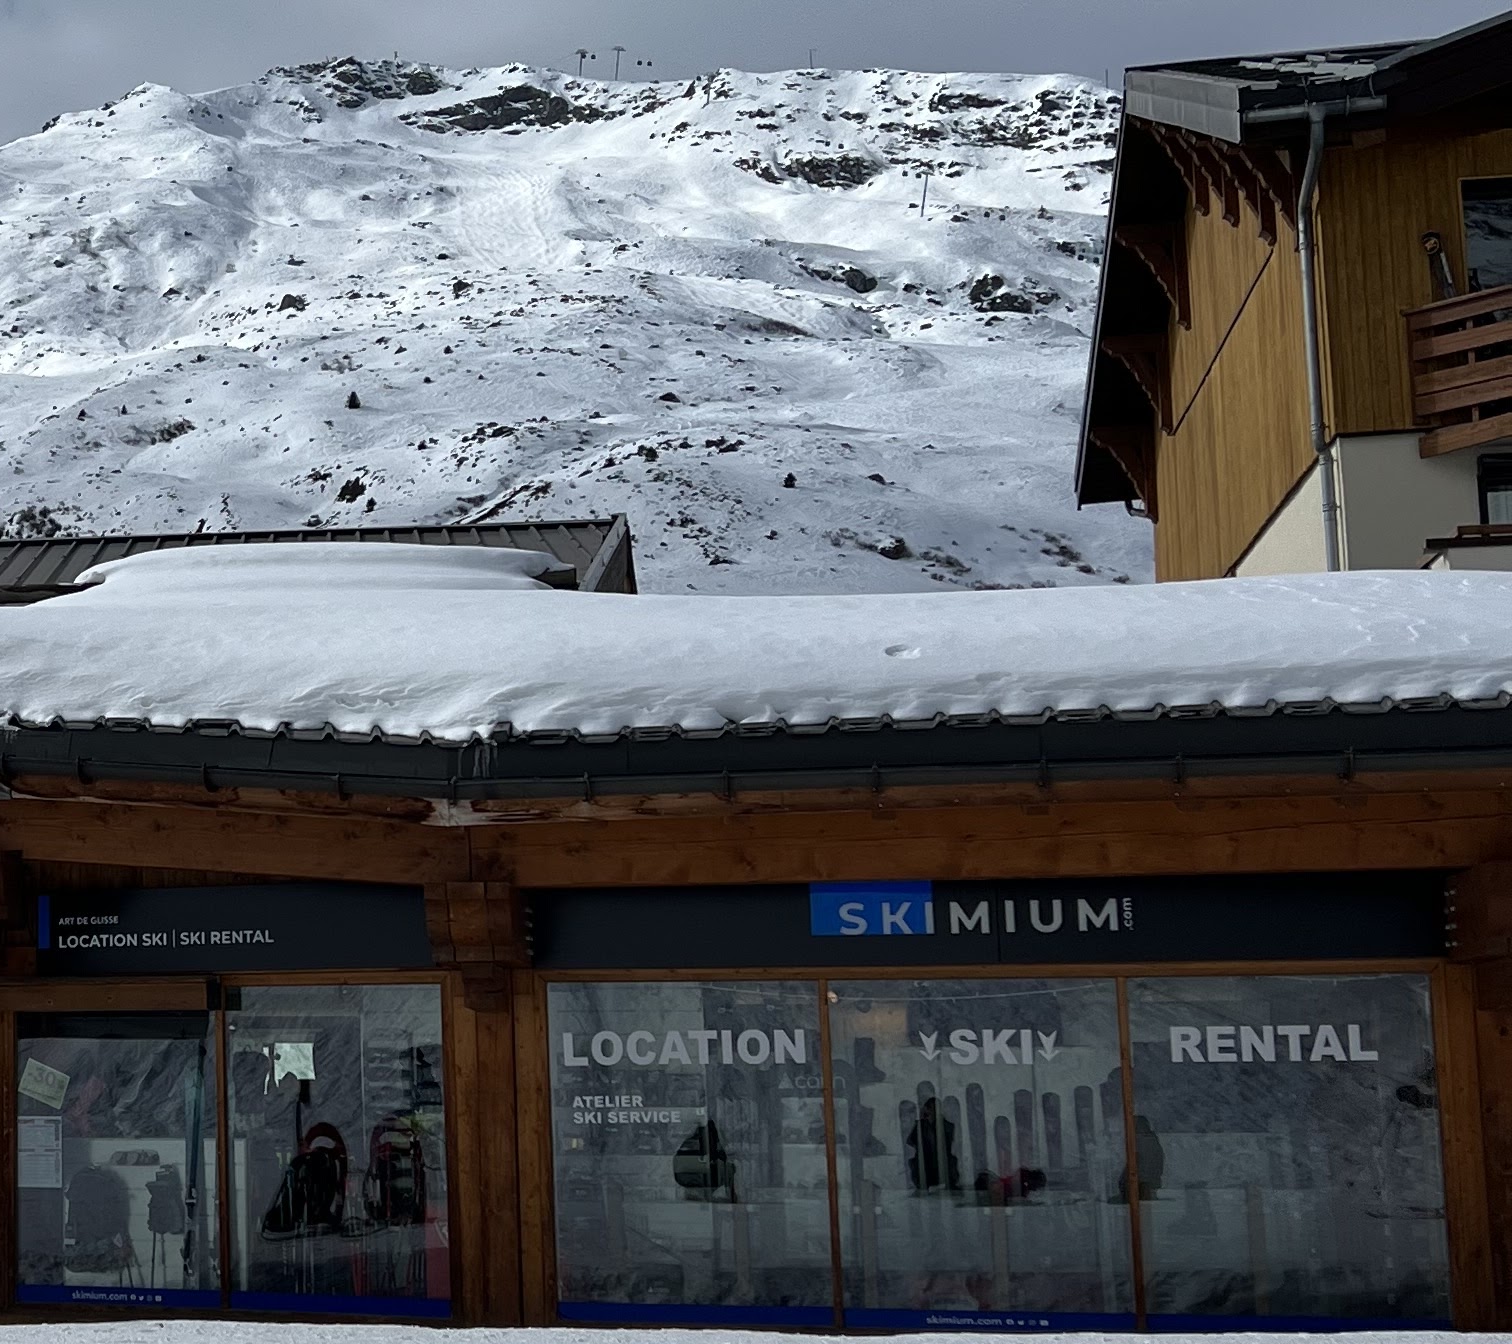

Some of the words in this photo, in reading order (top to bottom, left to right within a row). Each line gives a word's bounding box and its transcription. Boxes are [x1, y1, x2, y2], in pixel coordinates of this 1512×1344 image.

[58, 917, 74, 926] ART
[77, 917, 88, 925] DE
[90, 916, 119, 924] GLISSE
[838, 897, 1120, 936] SKIMIUM
[58, 933, 138, 949] LOCATION
[142, 932, 167, 947] SKI
[180, 931, 206, 945] SKI
[210, 929, 275, 945] RENTAL
[562, 1028, 807, 1067] LOCATION
[948, 1028, 1034, 1065] SKI
[1169, 1023, 1379, 1063] RENTAL
[572, 1095, 644, 1108] ATELIER
[573, 1111, 602, 1125] SKI
[607, 1110, 681, 1124] SERVICE
[72, 1290, 128, 1301] skimium.com
[926, 1315, 1002, 1326] skimium.com
